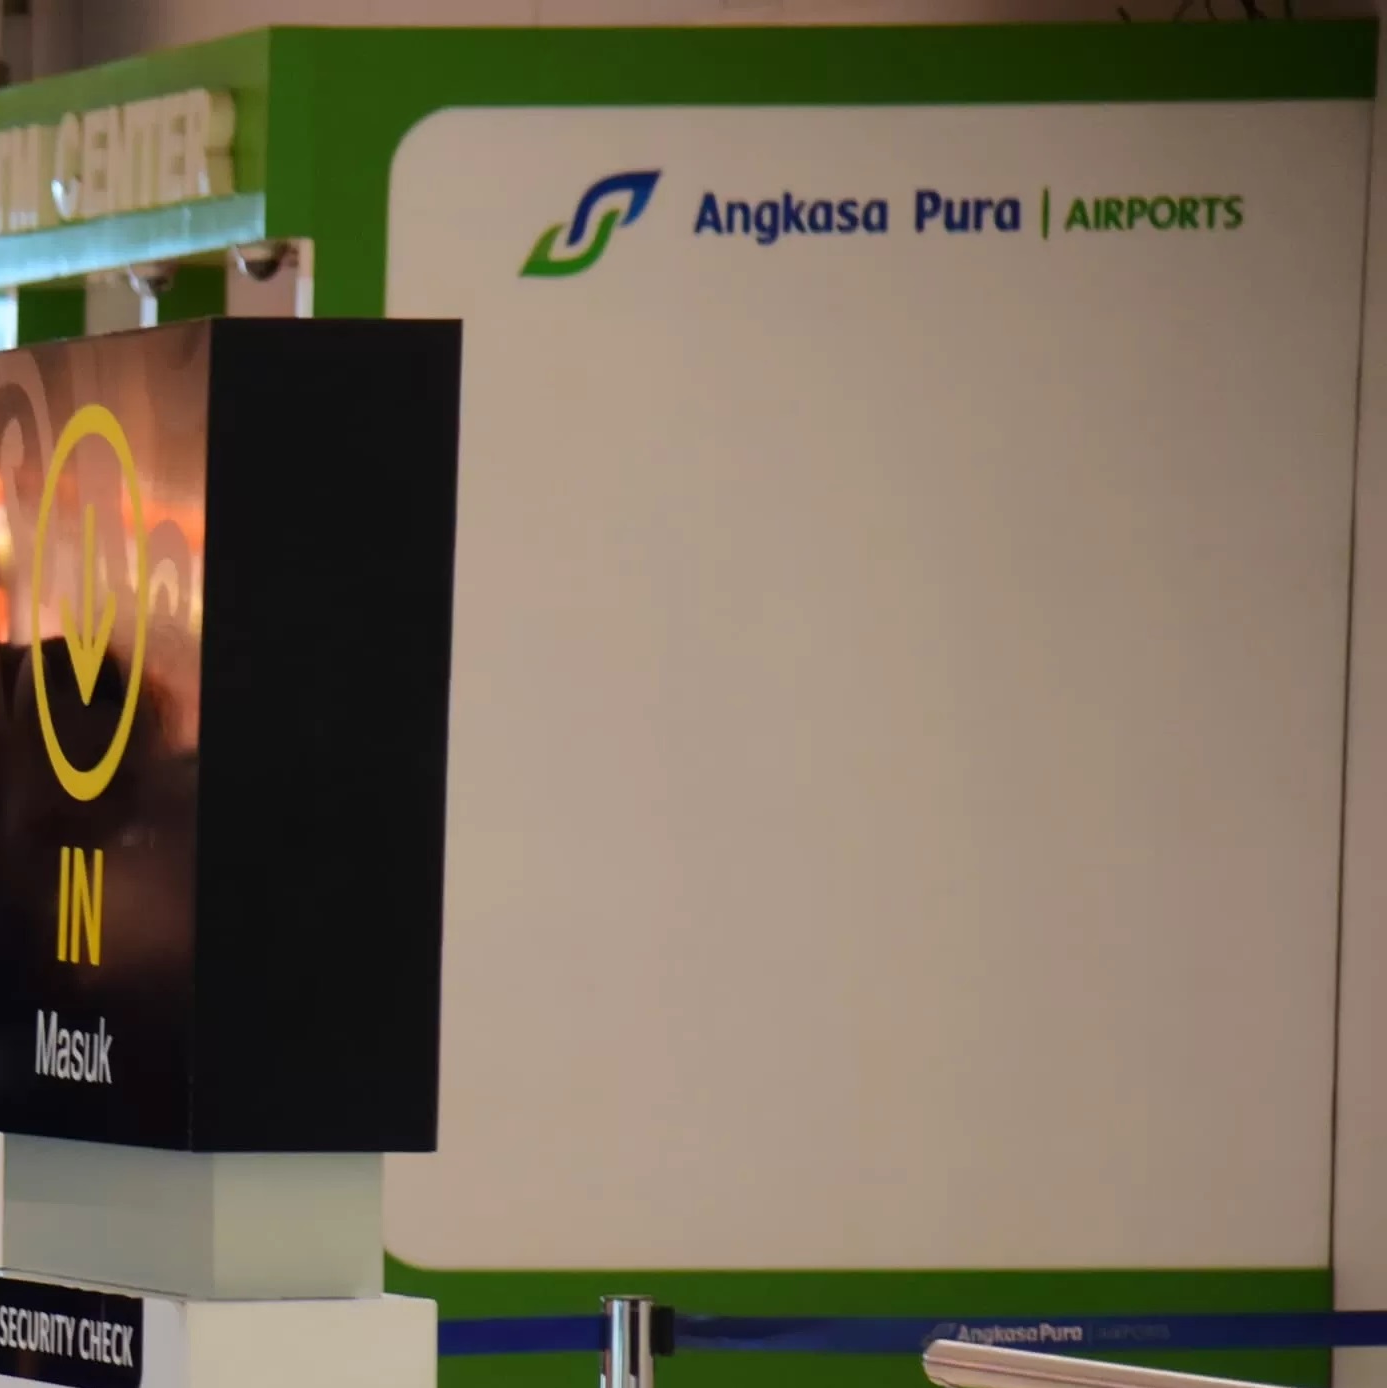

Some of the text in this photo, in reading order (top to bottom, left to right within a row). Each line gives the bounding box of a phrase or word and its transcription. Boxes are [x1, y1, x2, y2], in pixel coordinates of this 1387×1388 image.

[694, 189, 1245, 246] Angkasa Pura AIRPORTS
[57, 846, 104, 966] IN
[35, 1009, 113, 1085] Masuk
[77, 1318, 134, 1369] CHECK
[1039, 1323, 1084, 1344] Pura
